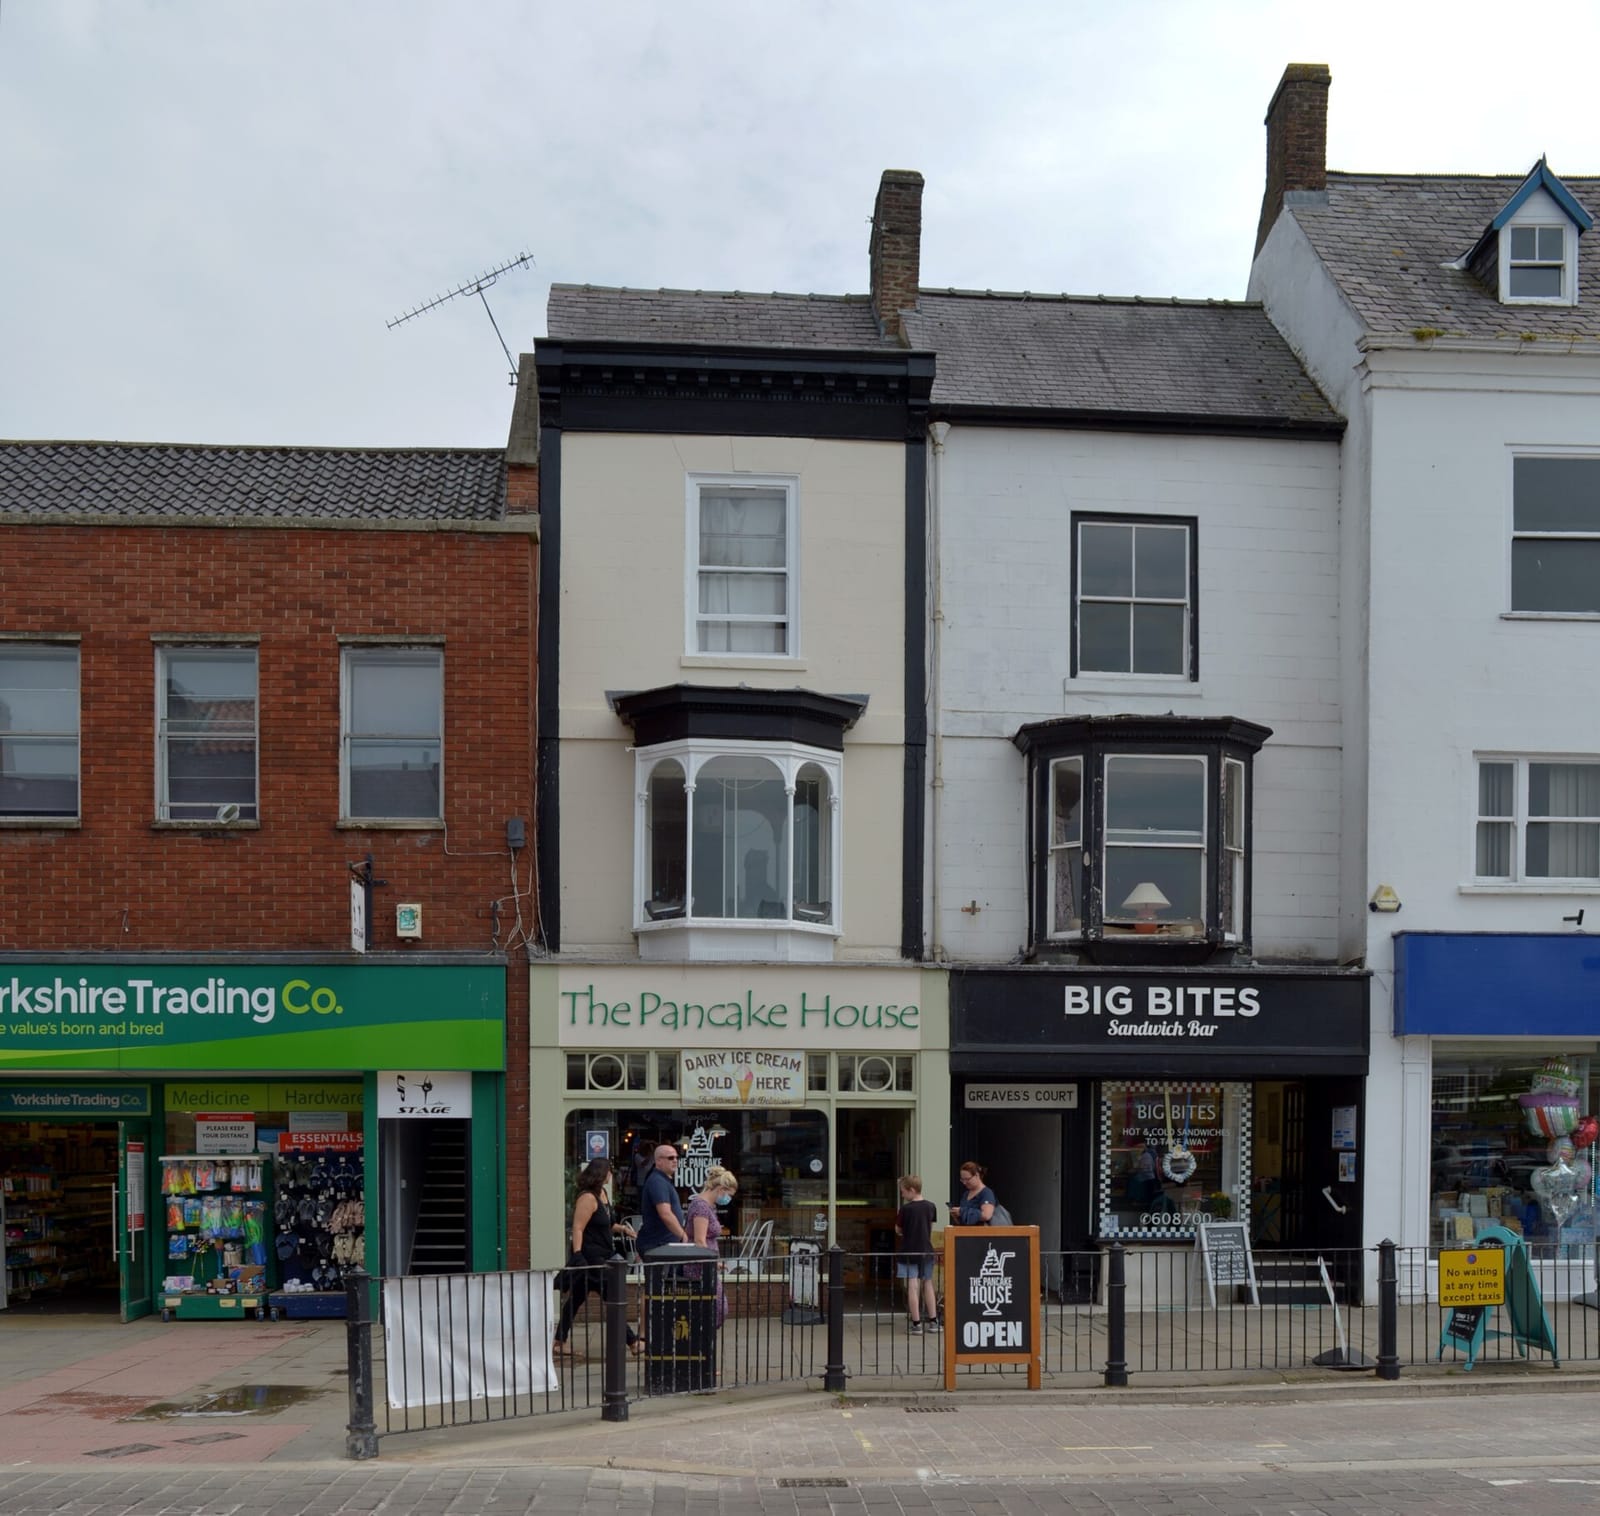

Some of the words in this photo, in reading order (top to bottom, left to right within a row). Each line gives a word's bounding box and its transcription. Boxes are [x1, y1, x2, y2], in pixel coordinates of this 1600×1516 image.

[128, 978, 275, 1023] Trading
[281, 979, 343, 1014] Co.
[1064, 985, 1133, 1015] BIG
[1147, 986, 1260, 1017] BITES
[561, 984, 632, 1026] The
[640, 990, 788, 1031] Pancake
[800, 992, 919, 1029] House
[10, 1022, 57, 1035] value's
[61, 1022, 95, 1035] born
[98, 1022, 126, 1035] and
[130, 1022, 164, 1035] bred
[1107, 1019, 1185, 1037] Sandwich
[1187, 1020, 1218, 1037] Bar
[685, 1053, 726, 1072] DAIRY
[731, 1051, 752, 1065] ICE
[756, 1052, 801, 1072] CREAM
[698, 1076, 733, 1090] SOLD
[756, 1077, 791, 1091] HERE
[11, 1094, 70, 1106] Yorkshire
[70, 1094, 120, 1108] Trading
[121, 1094, 141, 1106] Co.
[172, 1089, 250, 1106] Medicine
[968, 1090, 1031, 1102] GREAVES'S
[1035, 1090, 1074, 1102] COURT
[397, 1106, 452, 1114] STAGE
[1137, 1104, 1164, 1120] BIG
[1171, 1104, 1217, 1120] BITES
[292, 1133, 363, 1143] ESSENTIALS
[1122, 1128, 1140, 1136] HOT
[1143, 1128, 1149, 1136] &
[1151, 1128, 1175, 1136] COLD
[1178, 1128, 1231, 1137] SANDWICHES
[1146, 1138, 1158, 1146] TO
[1160, 1138, 1181, 1146] TAKE
[1184, 1138, 1208, 1146] AWAY
[1151, 1212, 1212, 1225] 608700
[1446, 1268, 1460, 1277] No
[1463, 1267, 1498, 1277] waiting
[969, 1276, 982, 1286] THE
[983, 1276, 1012, 1287] PANCAKE
[1445, 1282, 1455, 1290] at
[1458, 1283, 1474, 1291] any
[970, 1286, 1013, 1304] HOUSE
[1443, 1293, 1475, 1303] except
[1478, 1292, 1501, 1301] taxis
[963, 1321, 1023, 1348] OPEN
